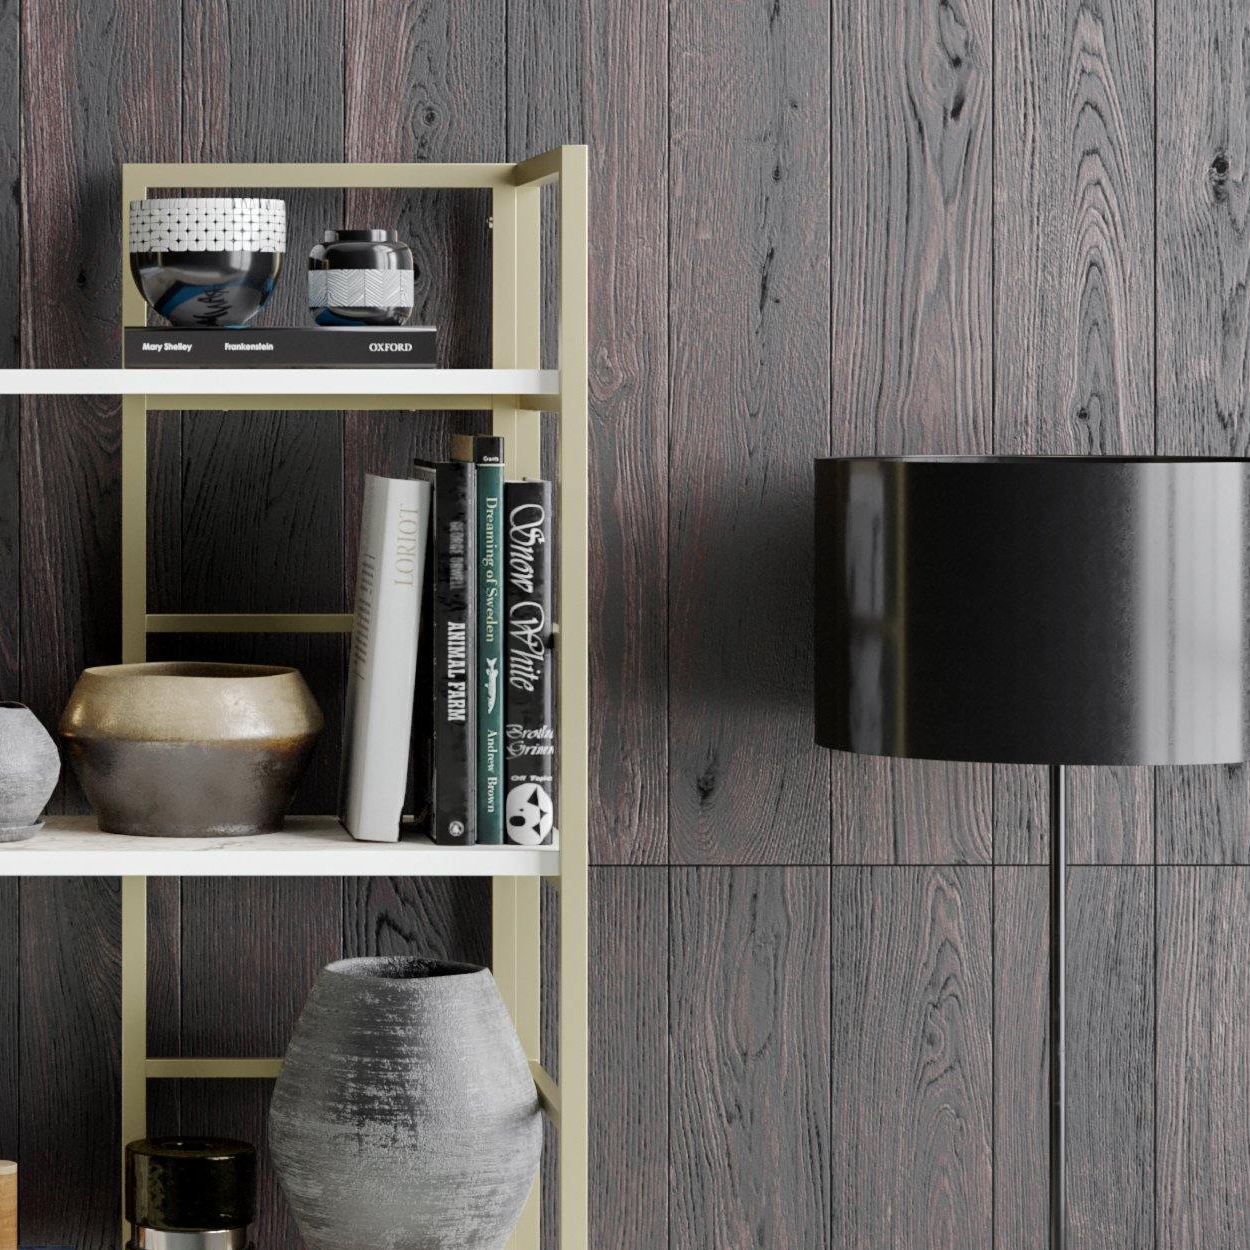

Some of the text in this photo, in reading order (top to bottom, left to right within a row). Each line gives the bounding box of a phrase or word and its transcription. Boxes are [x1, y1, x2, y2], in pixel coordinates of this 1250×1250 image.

[142, 342, 192, 352] Mary Shelley
[224, 342, 274, 351] Frankenstein
[368, 342, 413, 352] OXFORD
[393, 504, 420, 588] LORIOT
[482, 497, 499, 643] Dreaming of Sweden
[509, 502, 546, 692] Snow White
[447, 621, 466, 721] ANIMAL FARM
[487, 729, 498, 813] Andrew Brown
